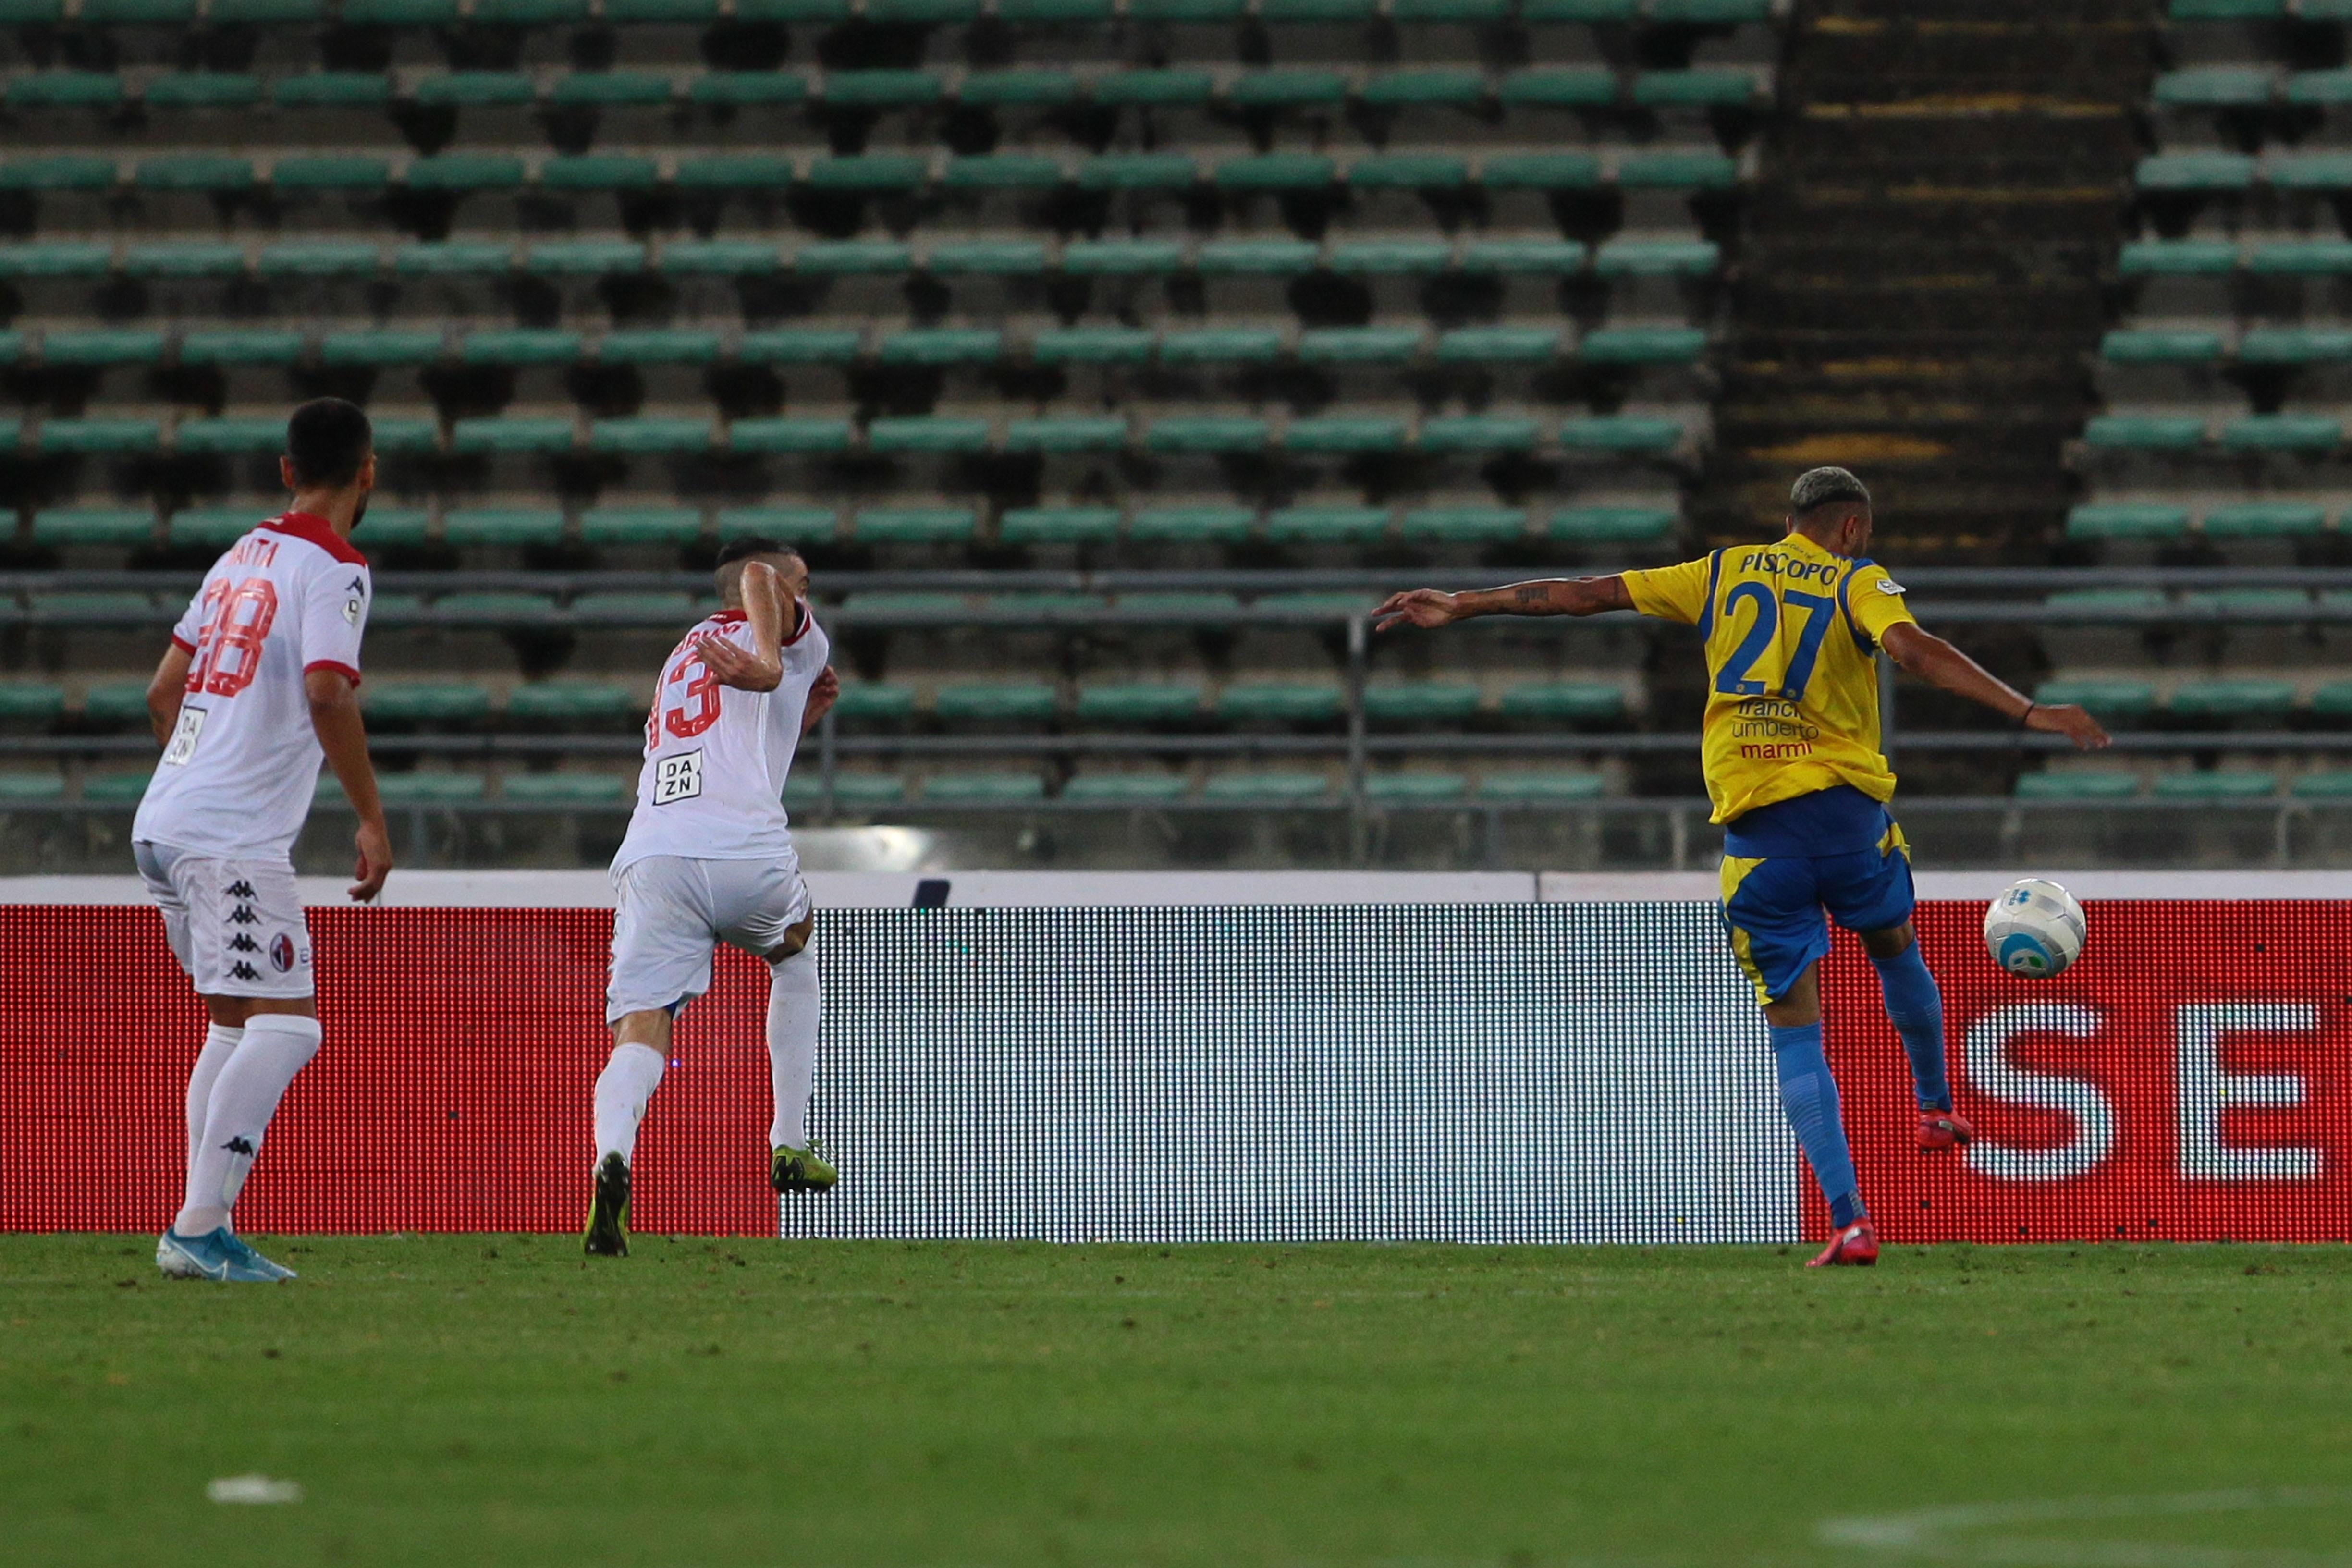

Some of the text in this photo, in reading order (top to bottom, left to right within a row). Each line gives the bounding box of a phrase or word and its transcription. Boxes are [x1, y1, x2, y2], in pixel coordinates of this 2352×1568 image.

[1740, 552, 1838, 585] PISCOPO
[1715, 582, 1835, 702] 27
[648, 650, 721, 751] 13
[1732, 720, 1819, 740] umberto
[1741, 743, 1813, 759] marmi
[667, 760, 692, 777] DA
[665, 776, 691, 796] ZN
